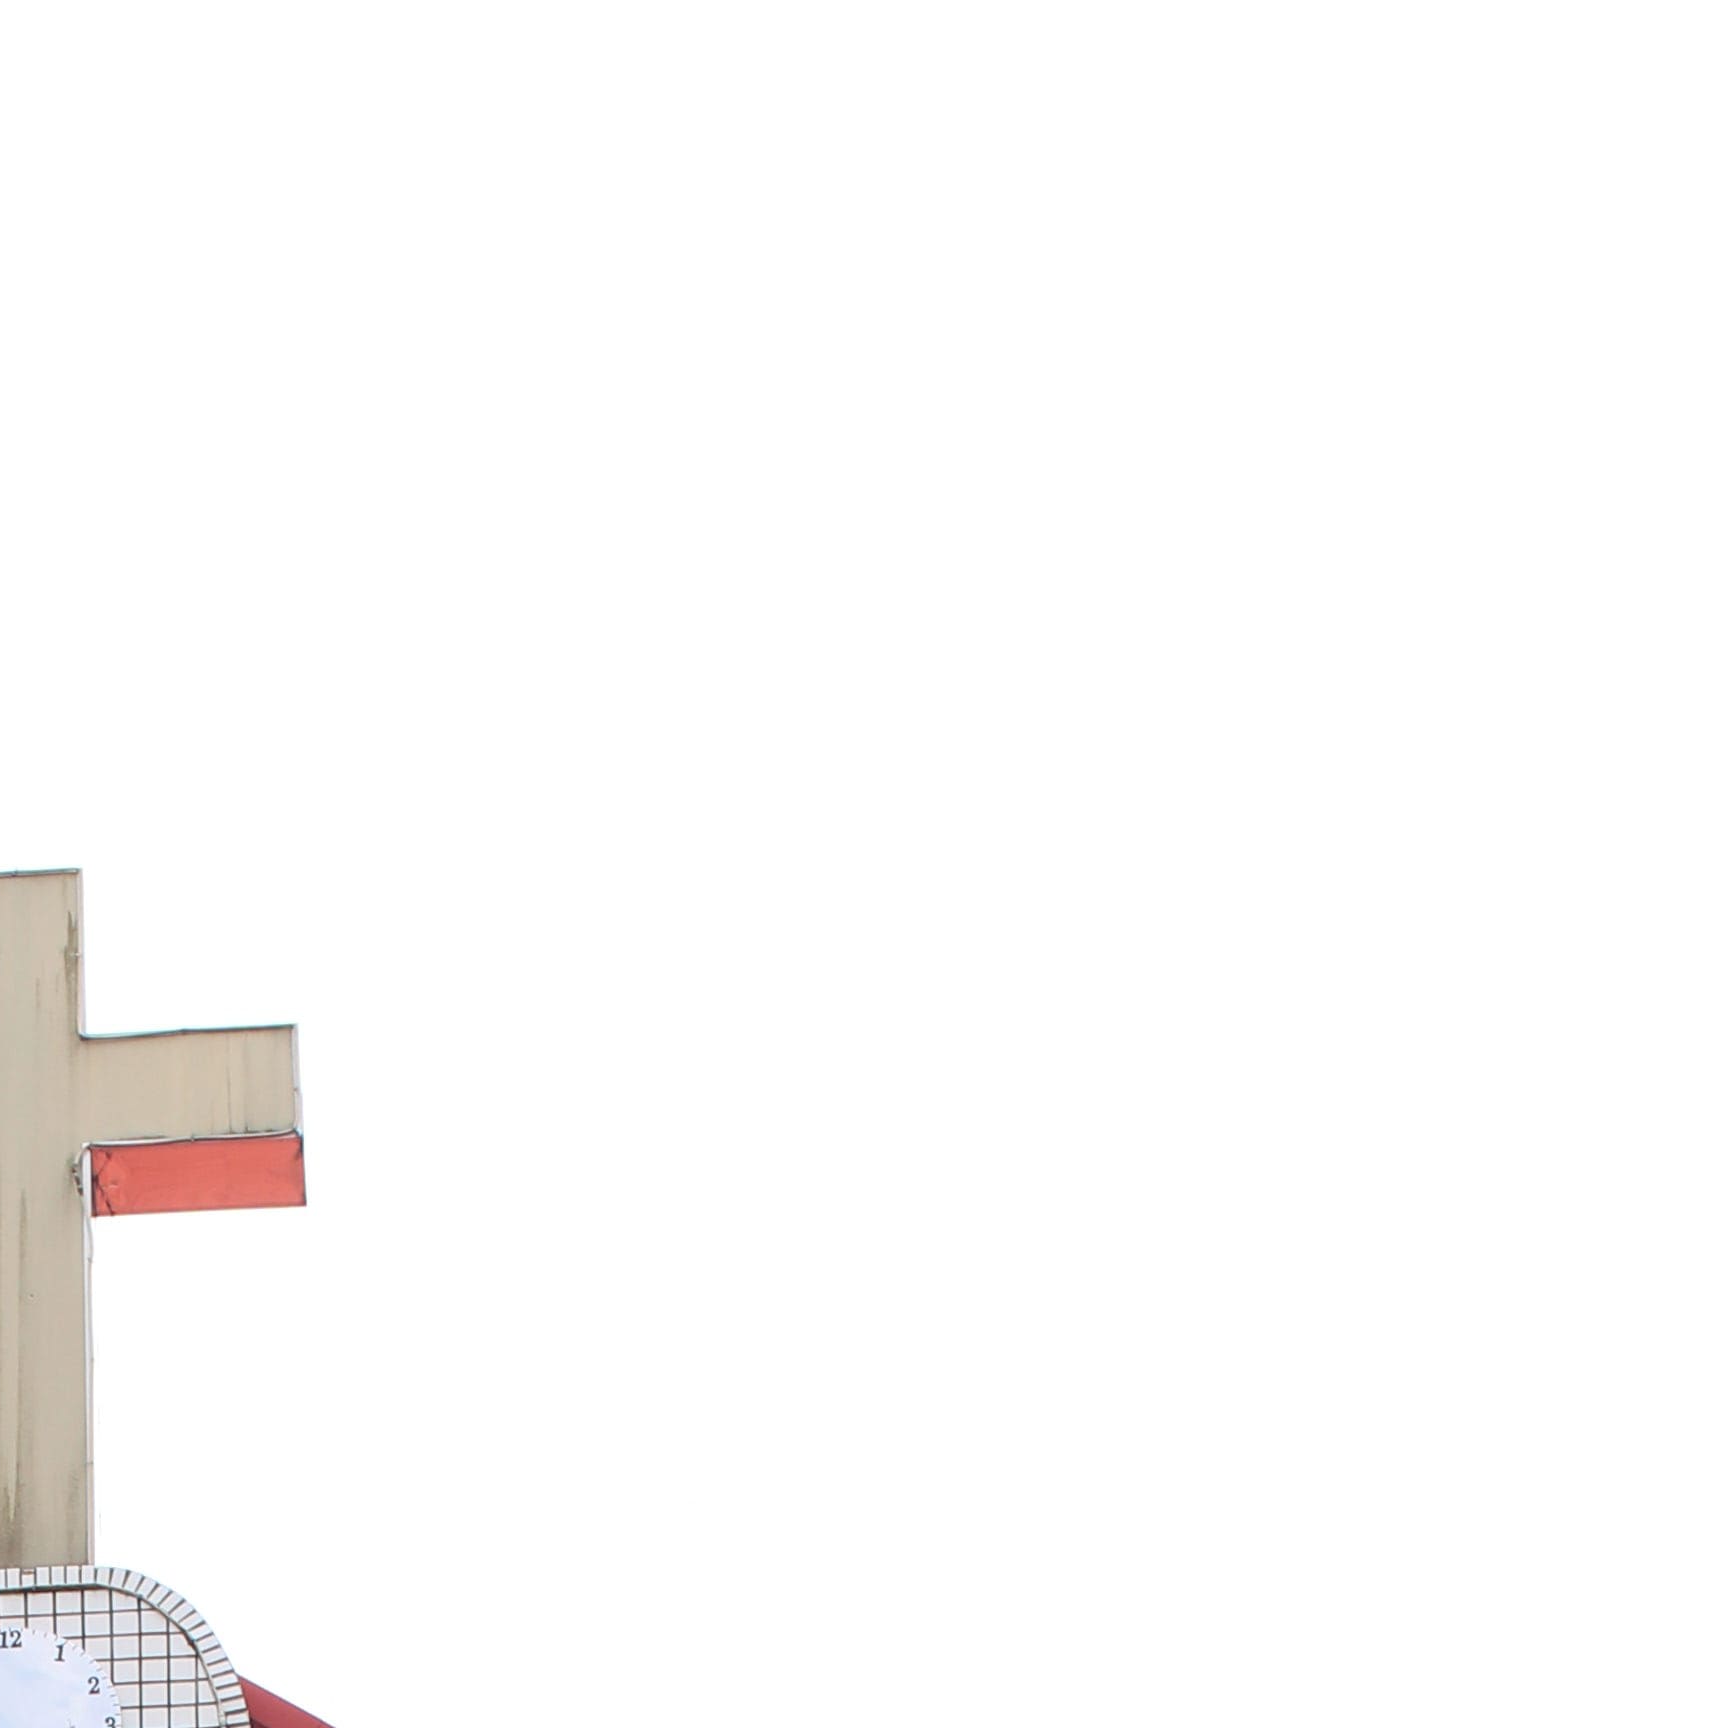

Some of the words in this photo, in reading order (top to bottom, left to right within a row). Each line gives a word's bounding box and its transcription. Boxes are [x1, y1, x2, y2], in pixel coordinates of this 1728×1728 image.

[0, 1630, 22, 1648] 12
[54, 1644, 65, 1662] 1
[87, 1677, 101, 1695] 2
